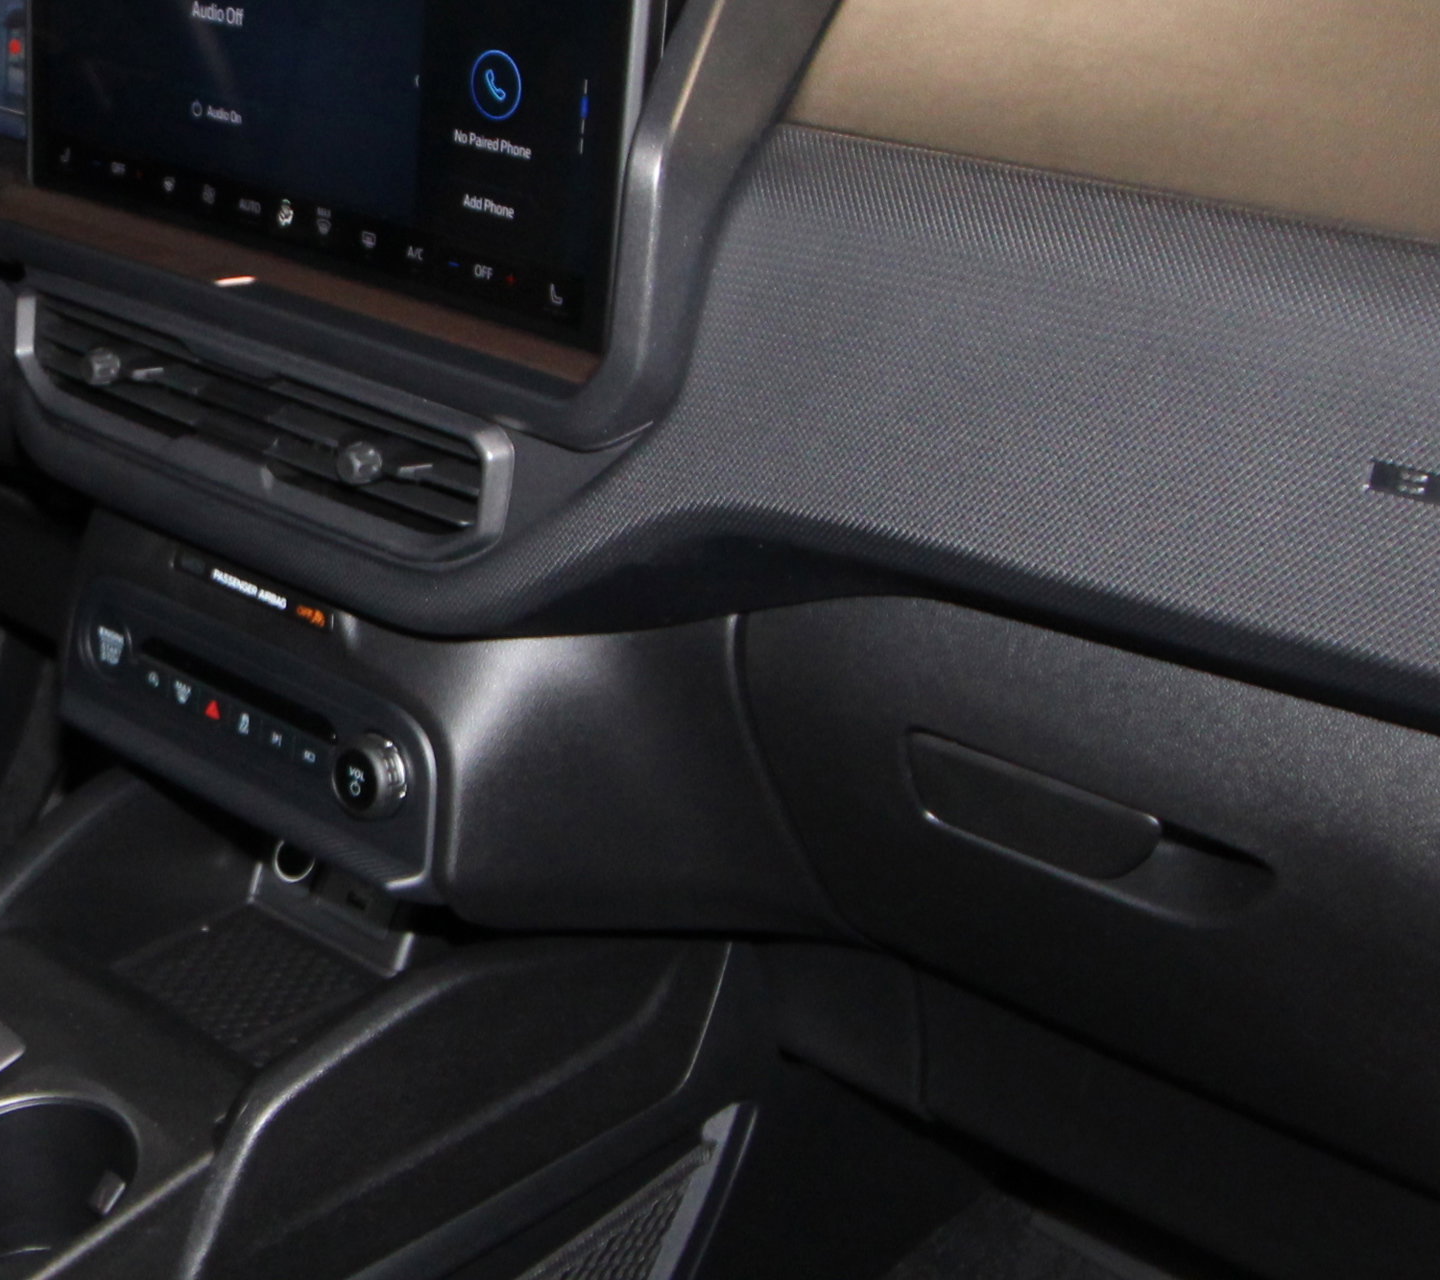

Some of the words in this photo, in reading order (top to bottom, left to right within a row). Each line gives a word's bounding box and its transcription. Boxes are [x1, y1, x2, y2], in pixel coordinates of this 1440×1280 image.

[192, 0, 224, 22] Audio
[226, 7, 244, 26] Off
[207, 105, 229, 121] Audio
[230, 110, 242, 124] On
[454, 129, 468, 143] No
[469, 132, 498, 151] Paired
[500, 139, 532, 159] Phone
[238, 198, 261, 215] AUTO
[463, 193, 482, 210] Add
[484, 198, 515, 218] Phone
[407, 245, 424, 261] A/C
[474, 263, 493, 280] OFF
[211, 569, 258, 595] PASSENGER
[349, 766, 365, 781] VOL
